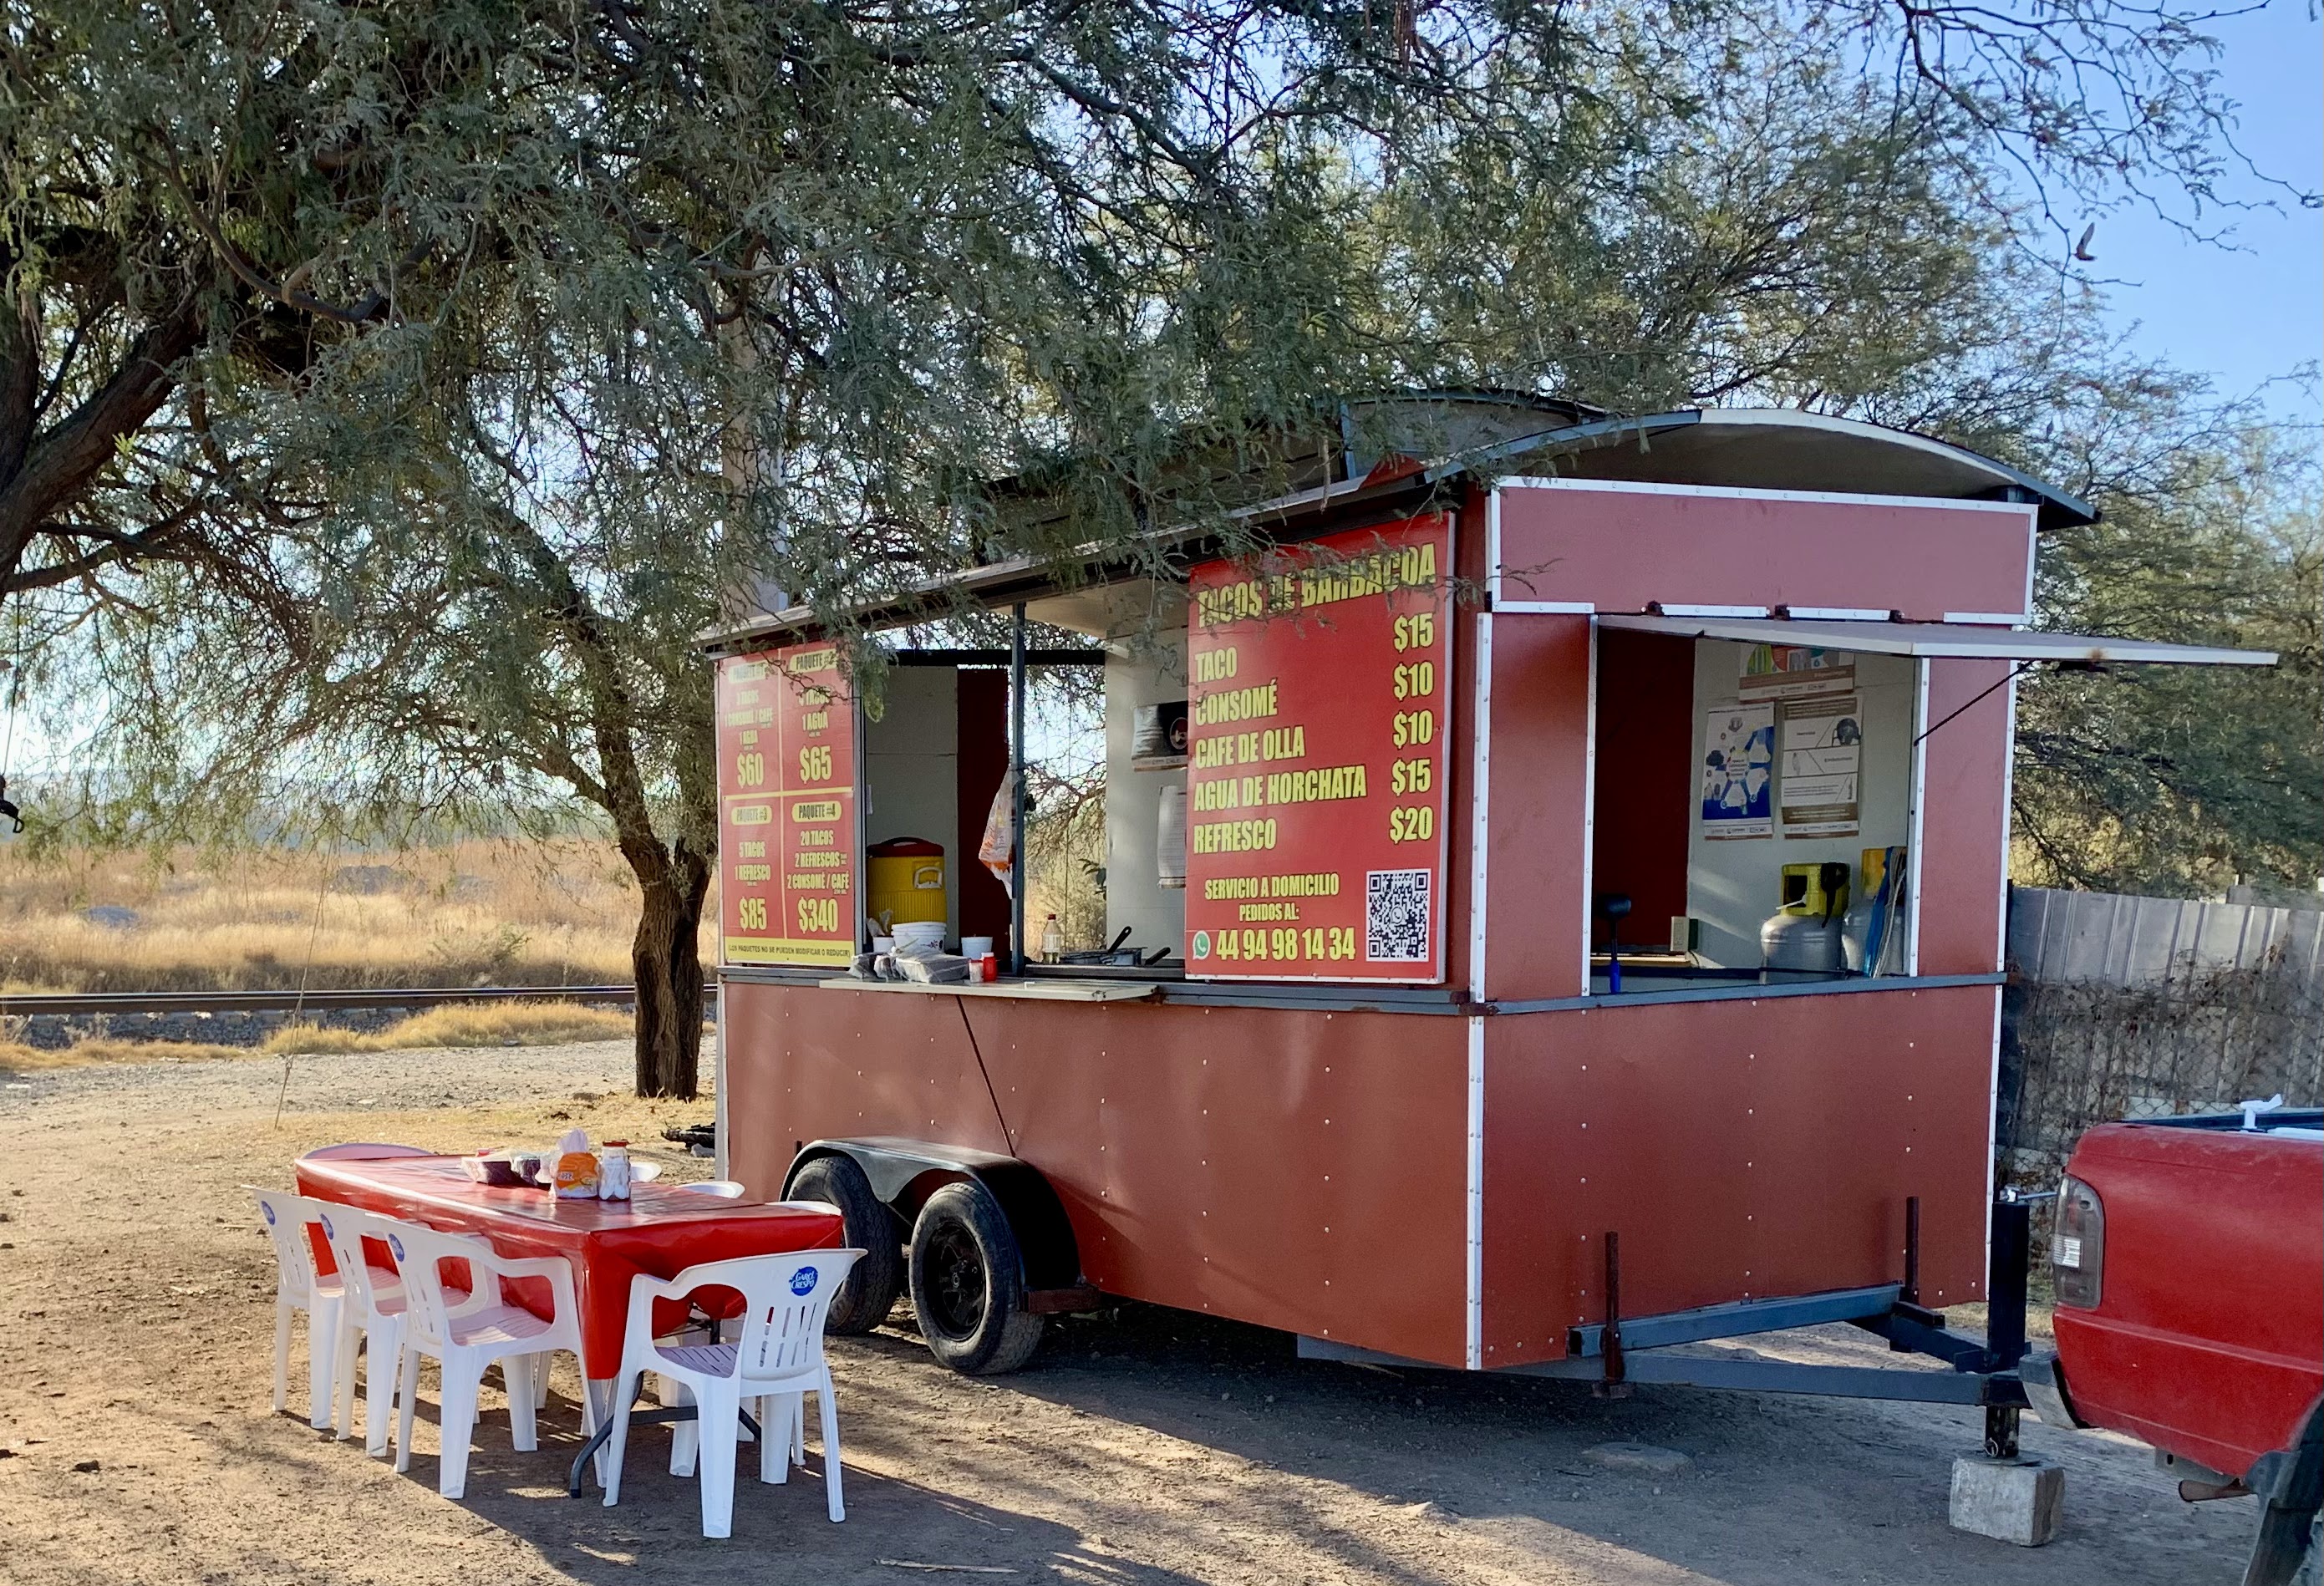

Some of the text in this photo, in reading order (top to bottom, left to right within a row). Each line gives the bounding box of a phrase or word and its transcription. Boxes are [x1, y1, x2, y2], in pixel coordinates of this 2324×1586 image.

[1198, 580, 1263, 628] TACOS
[1269, 572, 1295, 614] DE
[796, 653, 822, 670] PAQUETE
[1194, 613, 1433, 683] TACO $15
[1194, 661, 1434, 726] CONSOMÉ $10
[802, 711, 828, 731] 1 AGUA
[1195, 709, 1433, 770] CAFE DE OLLA $10
[736, 751, 765, 789] $60
[799, 745, 832, 784] $65
[1193, 759, 1432, 811] AGUA DE HORCHATA $15
[798, 803, 836, 820] PAQUETE #4
[801, 830, 834, 846] 20 TACOS
[1193, 818, 1277, 854] REFRESCO
[1389, 806, 1433, 844] $20
[739, 841, 765, 858] 5 TACOS
[795, 852, 800, 867] 2
[800, 851, 840, 867] REFRESCOS
[735, 864, 770, 881] 1 REFRESCO
[787, 870, 849, 889] 2 CONSOMÉ / CAFÉ
[1204, 873, 1340, 900] SERVICIO A DOMICILIO
[739, 897, 767, 932] $85
[798, 897, 838, 933] $340
[1238, 902, 1299, 922] PEDIDOS AL:
[1216, 927, 1356, 960] 44 94 98 14 34
